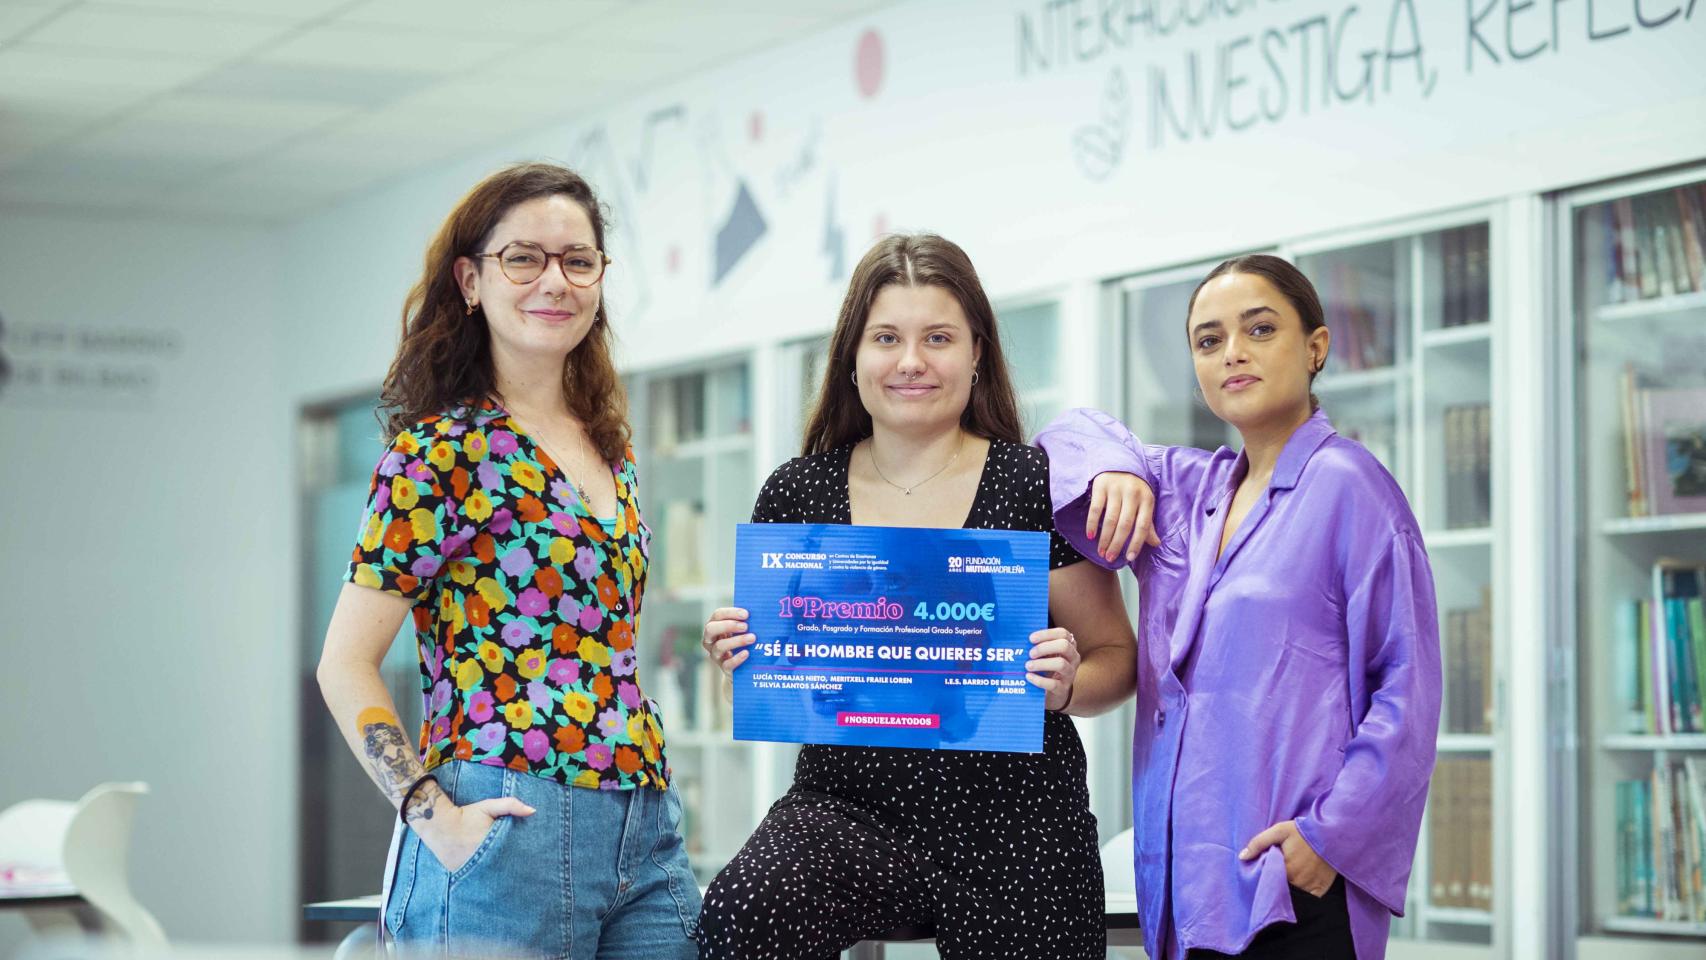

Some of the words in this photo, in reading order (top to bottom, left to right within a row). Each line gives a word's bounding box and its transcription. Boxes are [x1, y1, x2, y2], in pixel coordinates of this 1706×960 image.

[1148, 0, 1438, 150] INVESTIGA,
[762, 553, 784, 568] IX
[948, 556, 962, 568] 20
[966, 556, 1000, 565] FUNDACIÓN
[966, 565, 1025, 574] MUTUAMADRILEÑA
[914, 602, 995, 621] 4.000€
[797, 624, 821, 632] Grado,
[822, 625, 853, 634] Posgrado
[860, 625, 893, 633] Formación
[895, 625, 930, 634] Profesional
[954, 627, 982, 635] Superior
[785, 644, 800, 657] EL
[804, 645, 874, 658] HOMBRE
[878, 646, 911, 660] QUE
[915, 647, 982, 661] QUIERES
[845, 716, 931, 726] #NOSDUELEATODOS
